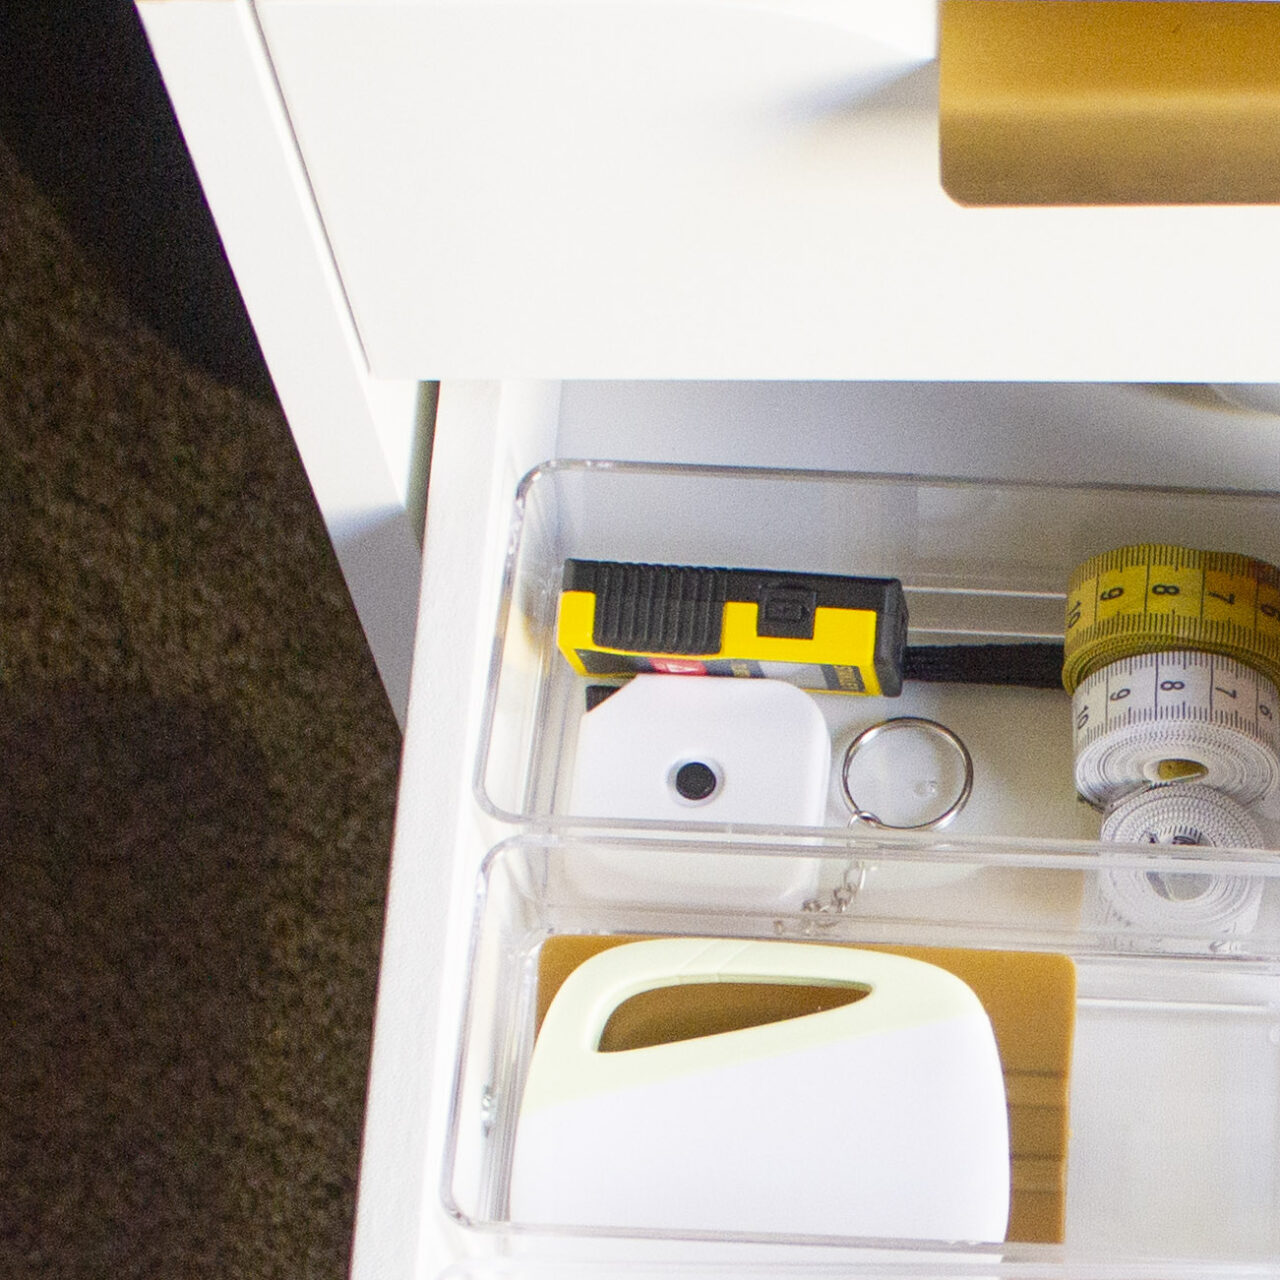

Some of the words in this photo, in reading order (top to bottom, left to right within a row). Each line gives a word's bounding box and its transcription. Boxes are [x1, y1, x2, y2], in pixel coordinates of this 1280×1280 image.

[1101, 587, 1124, 601] 9
[1152, 584, 1180, 595] 8
[1208, 591, 1235, 606] 7
[1067, 601, 1082, 628] 10
[1160, 680, 1185, 691] 8
[1215, 686, 1237, 699] 7
[1110, 688, 1131, 702] 9
[1076, 705, 1089, 730] 10
